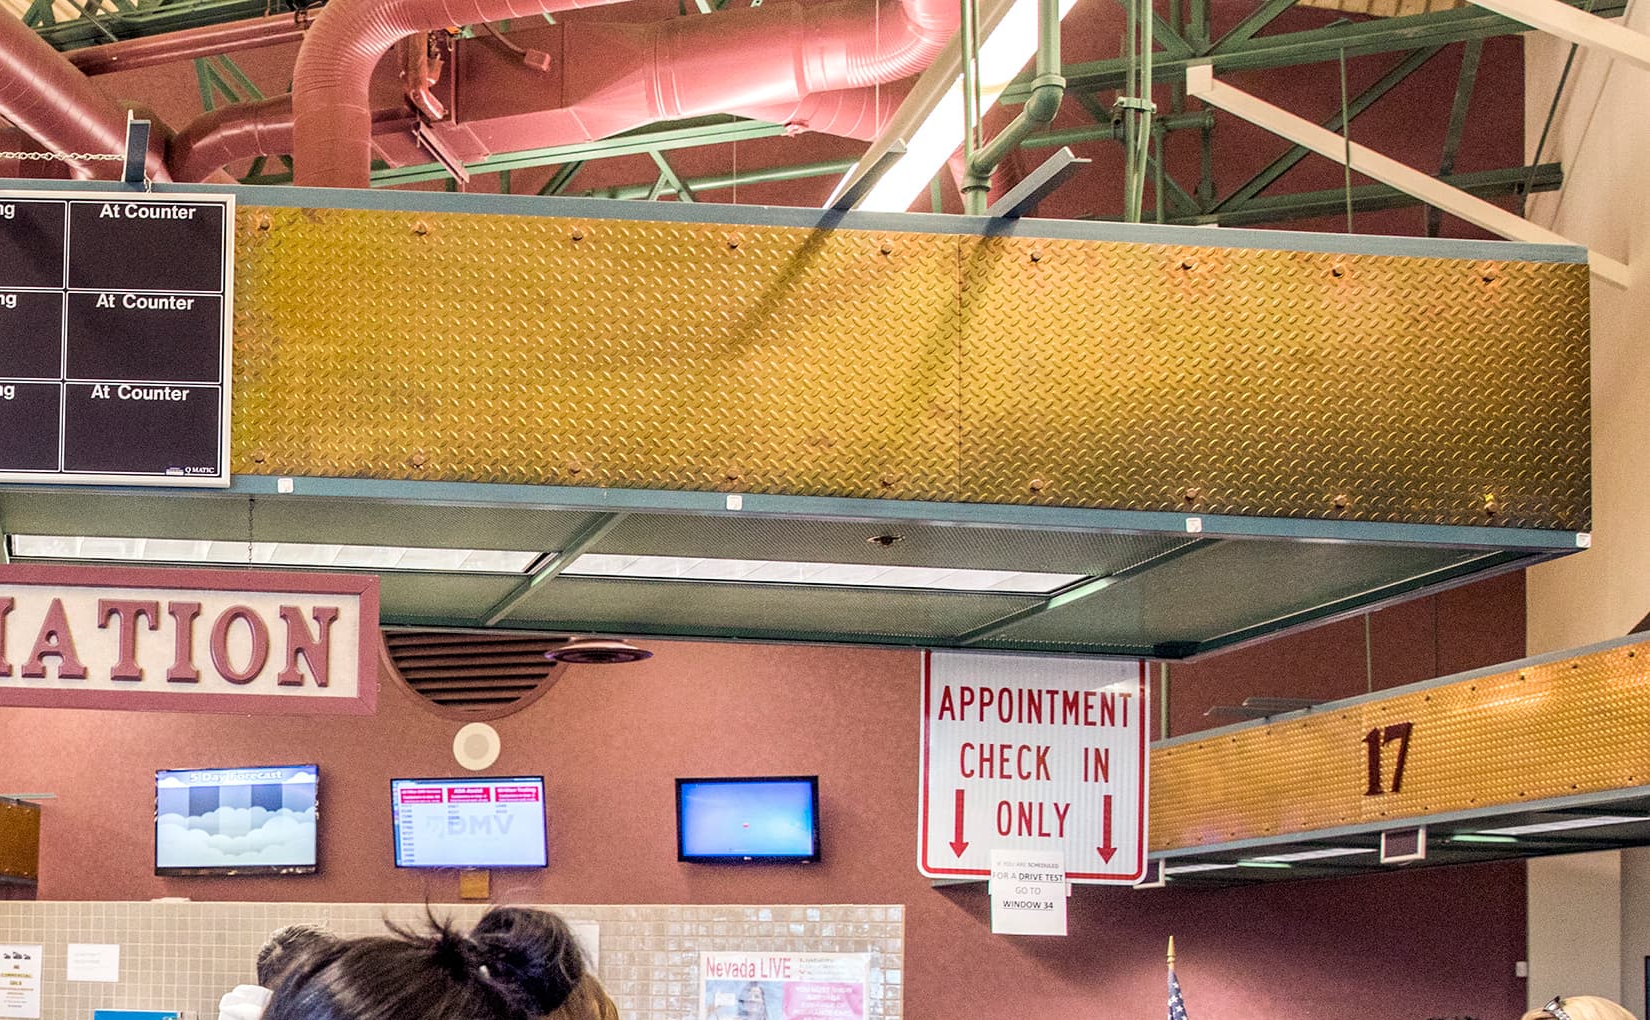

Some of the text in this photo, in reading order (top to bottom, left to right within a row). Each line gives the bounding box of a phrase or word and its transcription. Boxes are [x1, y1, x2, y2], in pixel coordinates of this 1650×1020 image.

[100, 205, 195, 220] At Counter
[96, 294, 194, 310] At Counter
[91, 385, 189, 400] At Counter
[938, 685, 1133, 728] APPOINTMENT
[960, 743, 1110, 783] CHECK IN
[1361, 722, 1413, 796] 17
[190, 770, 282, 783] 5 Day Forecast
[448, 814, 514, 835] DMV
[996, 799, 1070, 839] ONLY
[1030, 887, 1041, 895] TO
[706, 957, 755, 978] Nevada
[760, 958, 791, 978] LIVE
